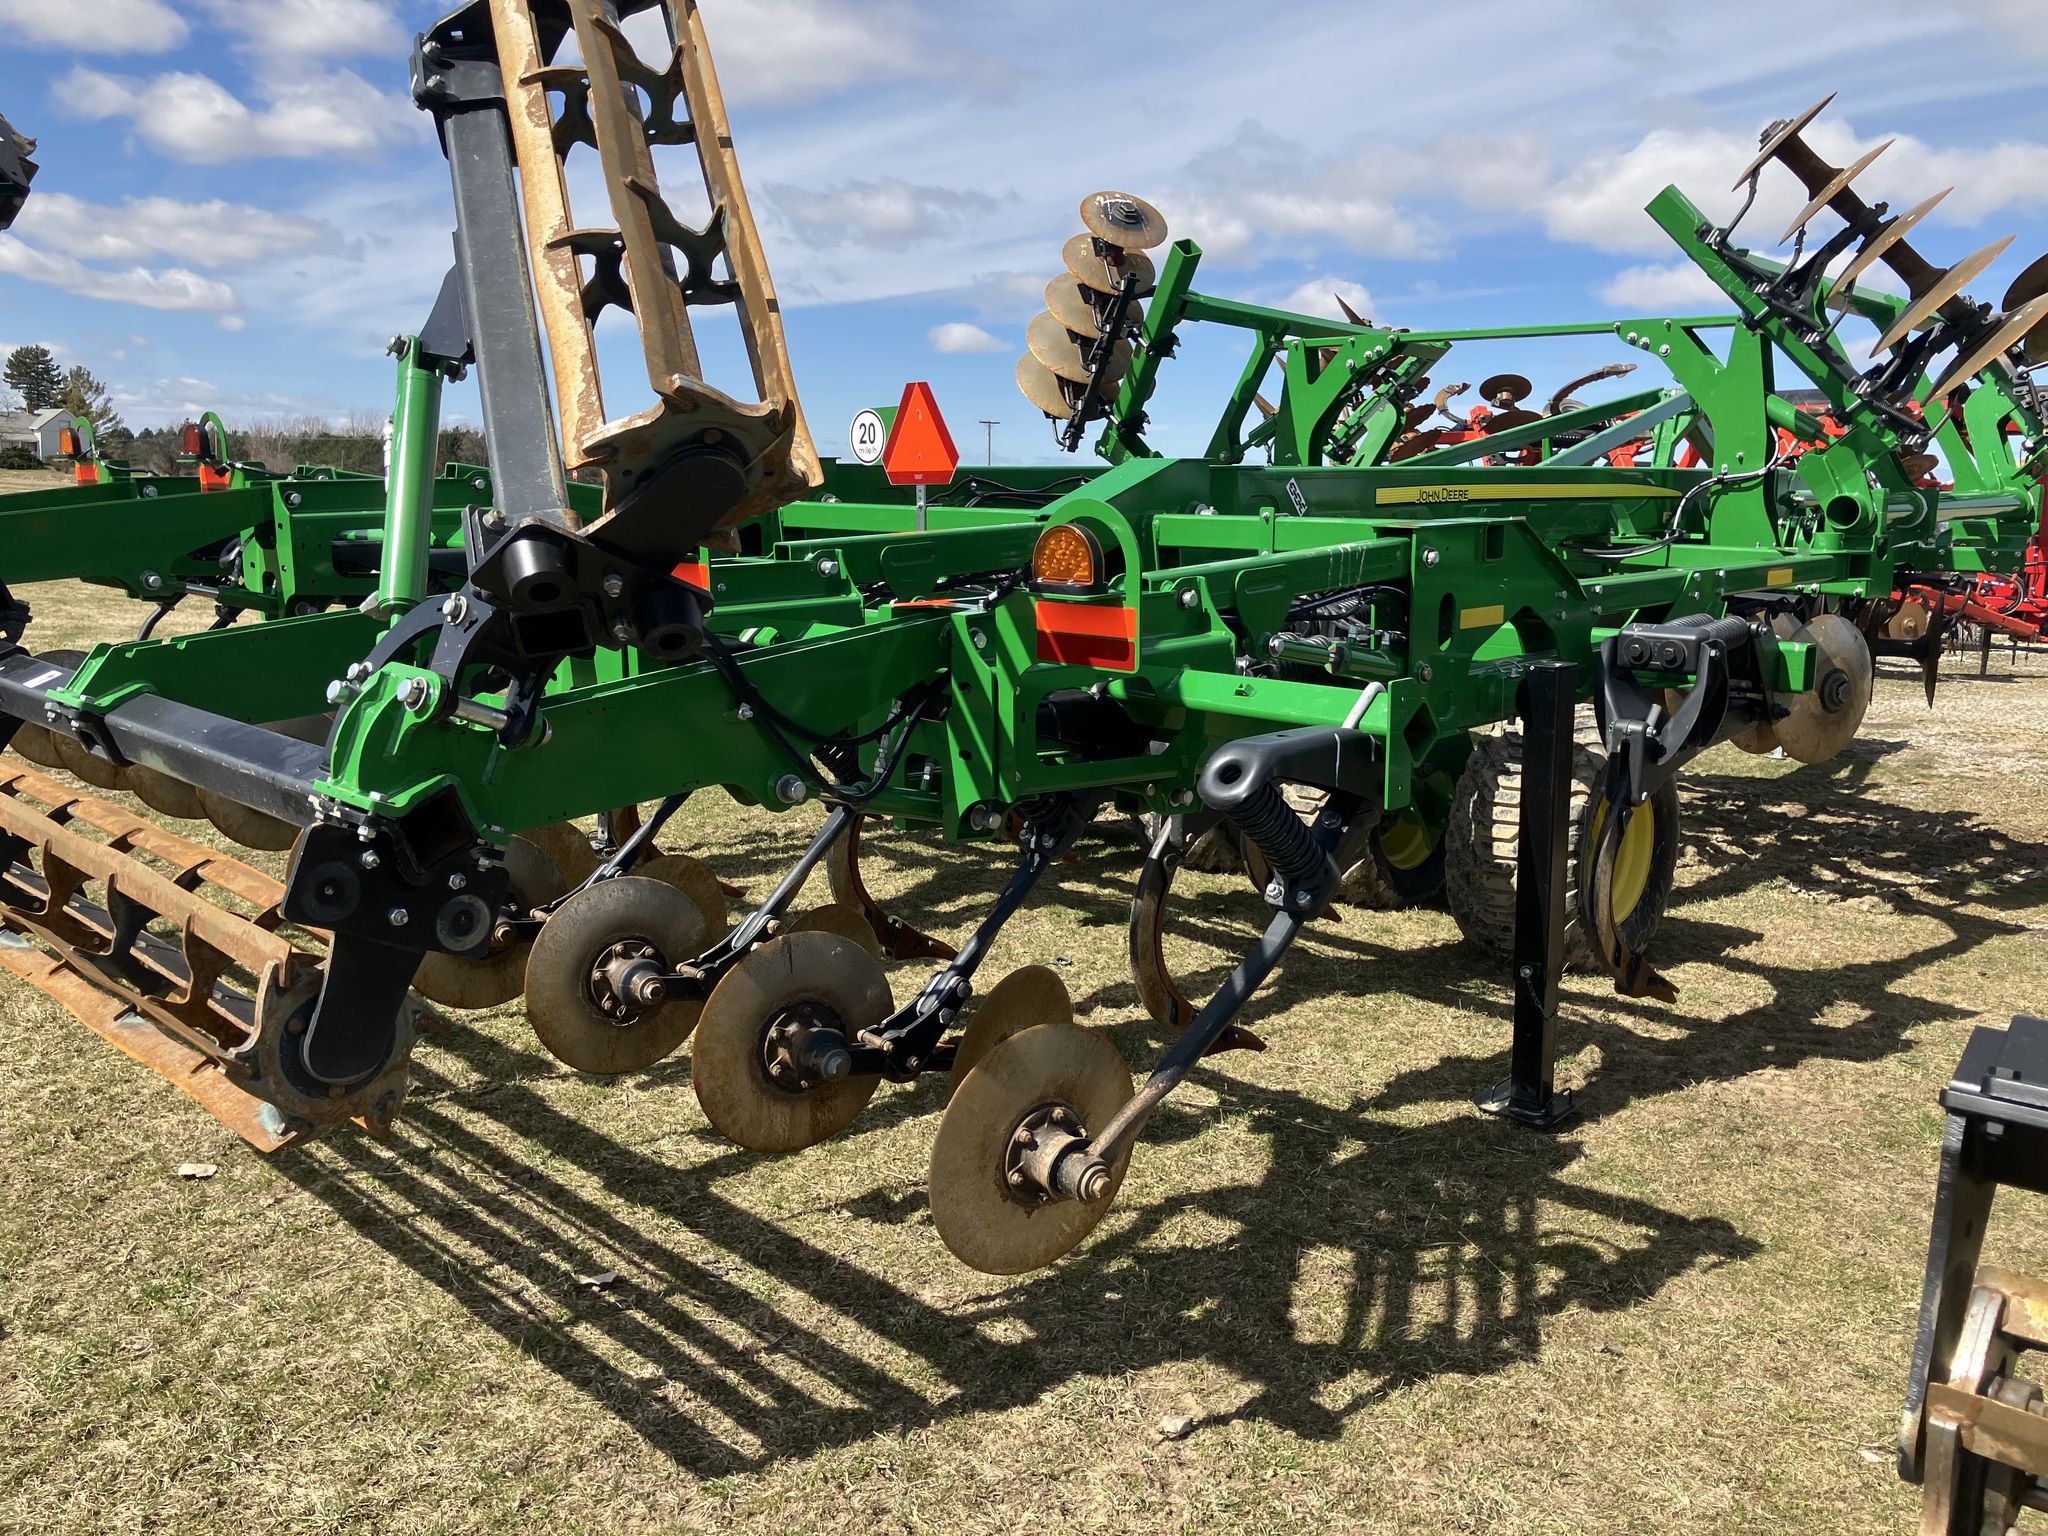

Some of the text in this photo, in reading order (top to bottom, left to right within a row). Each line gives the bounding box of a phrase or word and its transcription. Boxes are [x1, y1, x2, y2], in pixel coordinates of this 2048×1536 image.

[859, 423, 876, 444] 20
[1415, 488, 1469, 502] JOHN DEERE
